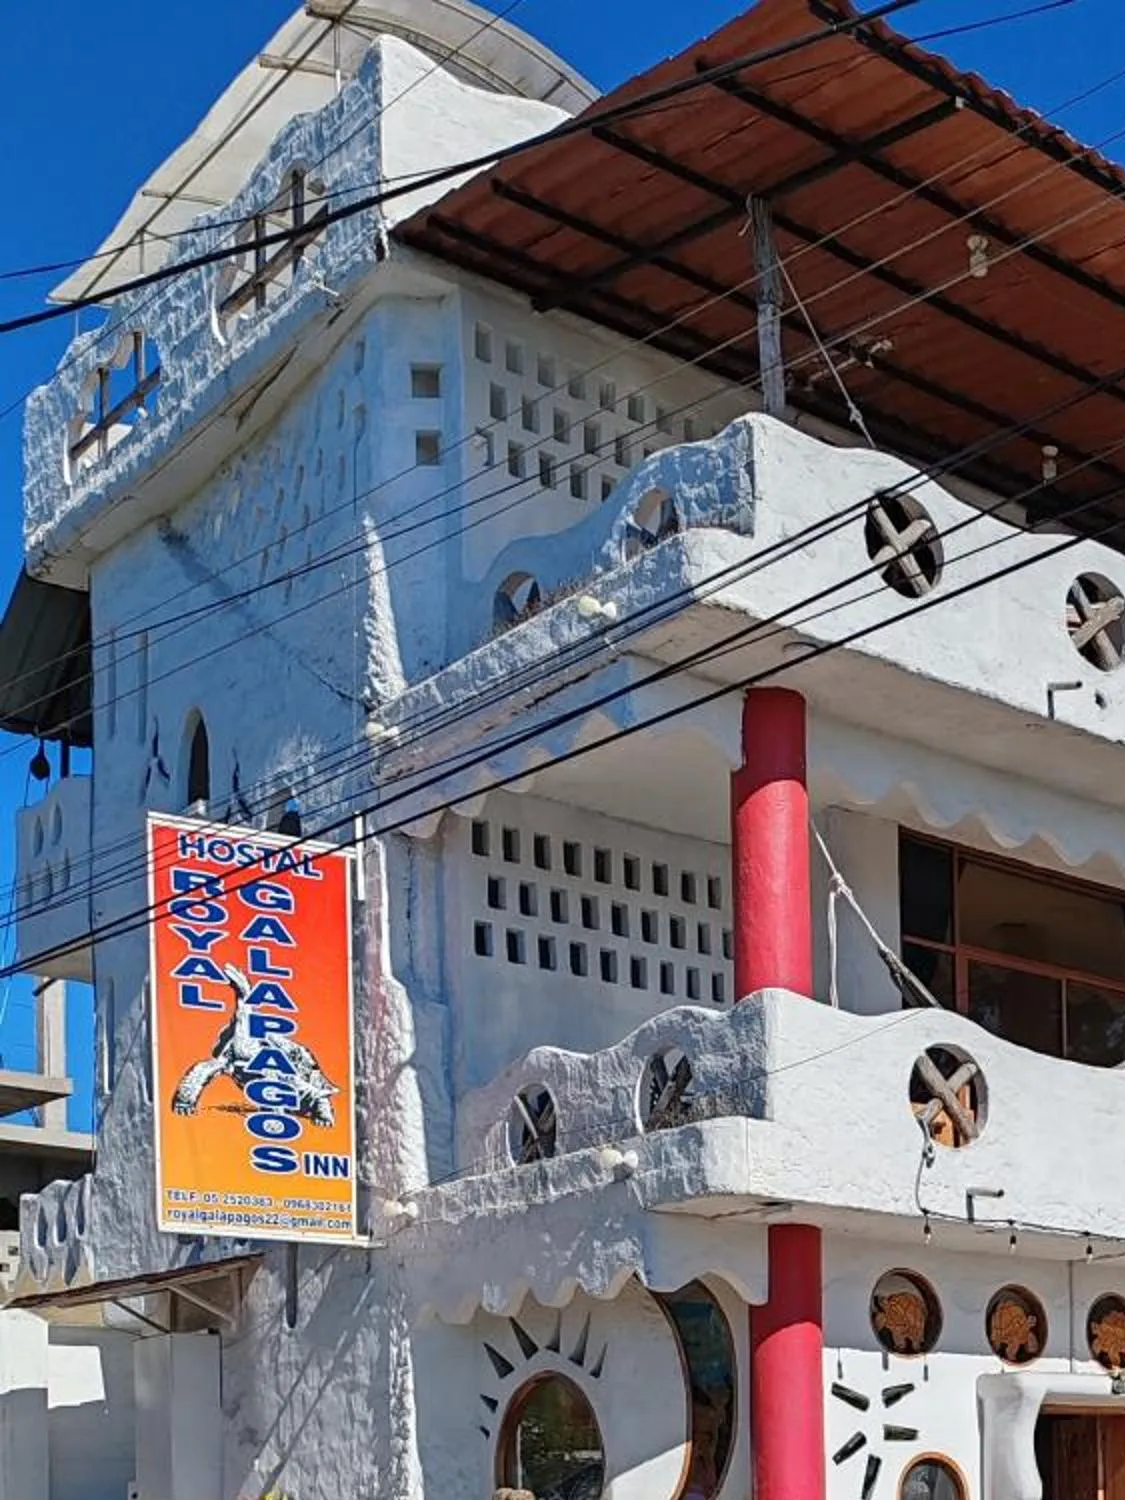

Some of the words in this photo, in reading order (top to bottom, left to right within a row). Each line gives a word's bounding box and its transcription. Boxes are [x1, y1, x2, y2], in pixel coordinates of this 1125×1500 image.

[179, 833, 322, 879] HOSTAL
[169, 868, 229, 1011] ROYAL
[239, 881, 300, 1174] GALAPAGOS
[303, 1153, 349, 1178] INN
